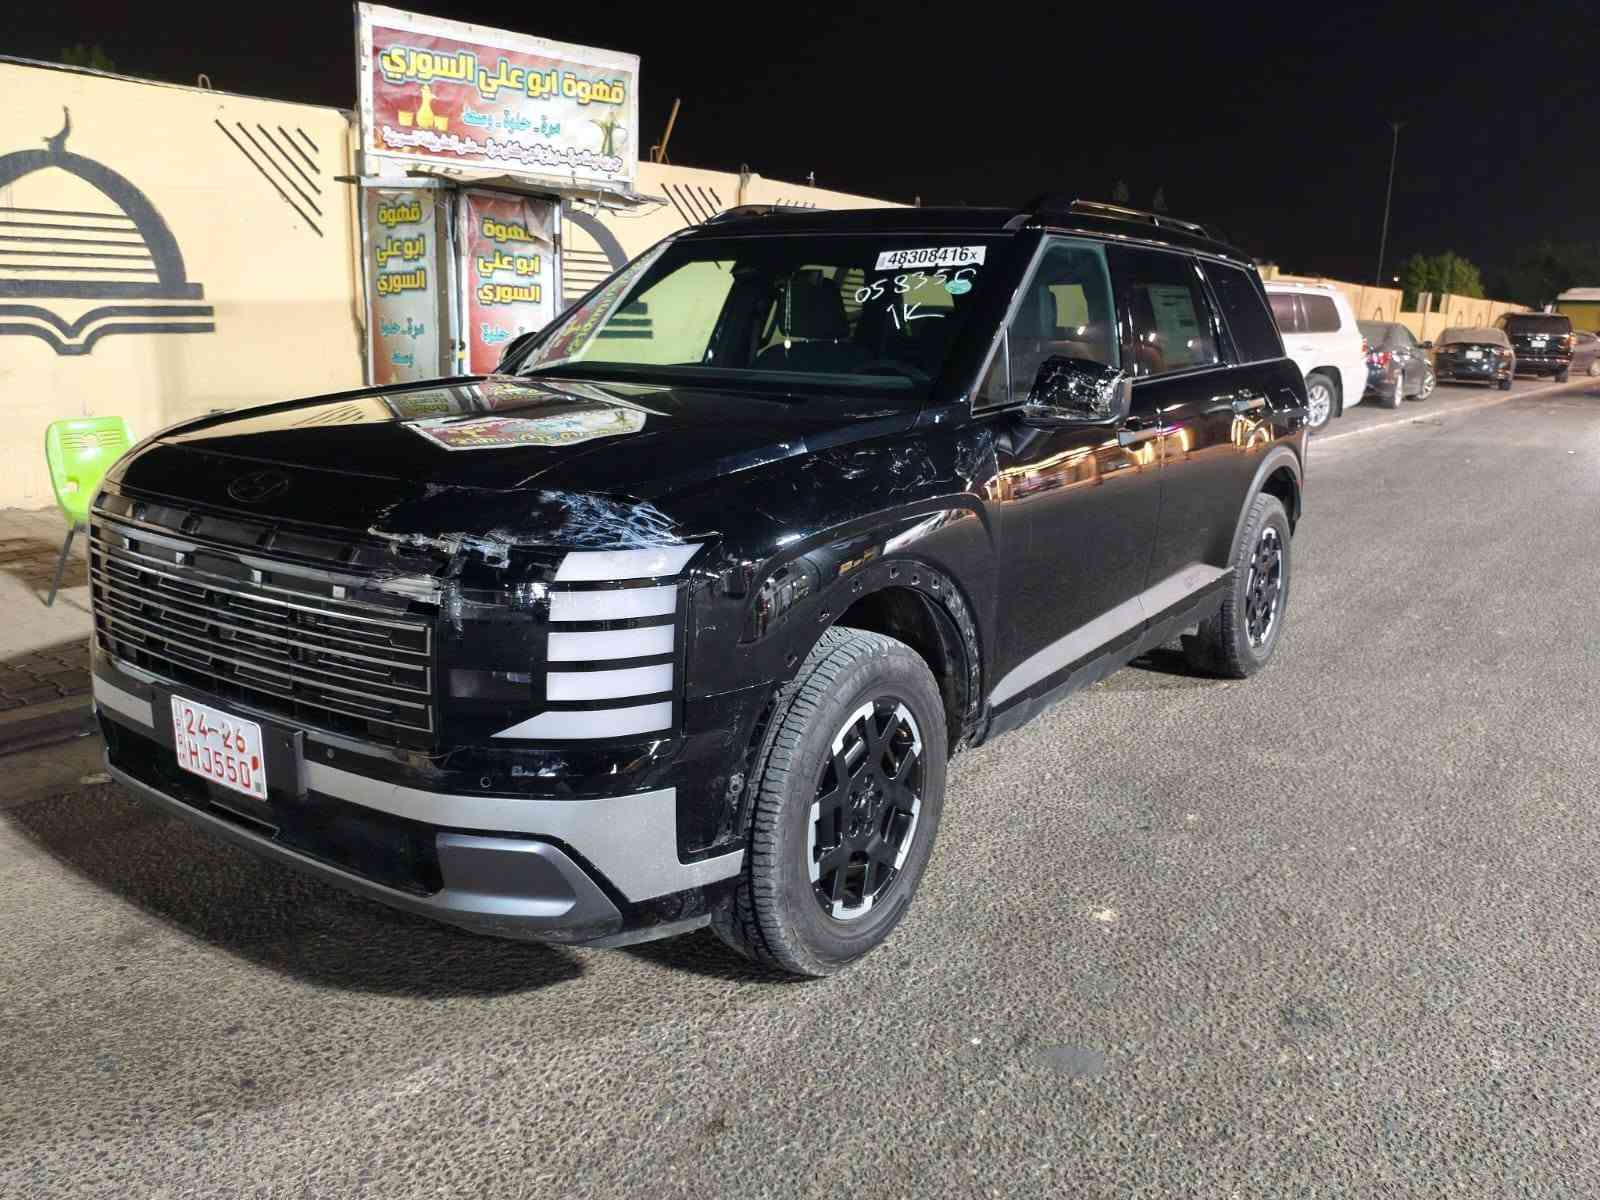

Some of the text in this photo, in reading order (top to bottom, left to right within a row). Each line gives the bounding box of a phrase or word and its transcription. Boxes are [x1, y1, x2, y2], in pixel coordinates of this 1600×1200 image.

[381, 47, 625, 105] قهوة ابو علي السوري
[378, 200, 422, 228] قهوة
[482, 216, 535, 243] هوة
[376, 235, 425, 267] ابو علي
[478, 250, 541, 276] ابو علي
[376, 269, 426, 296] السوري
[477, 283, 541, 305] السوري
